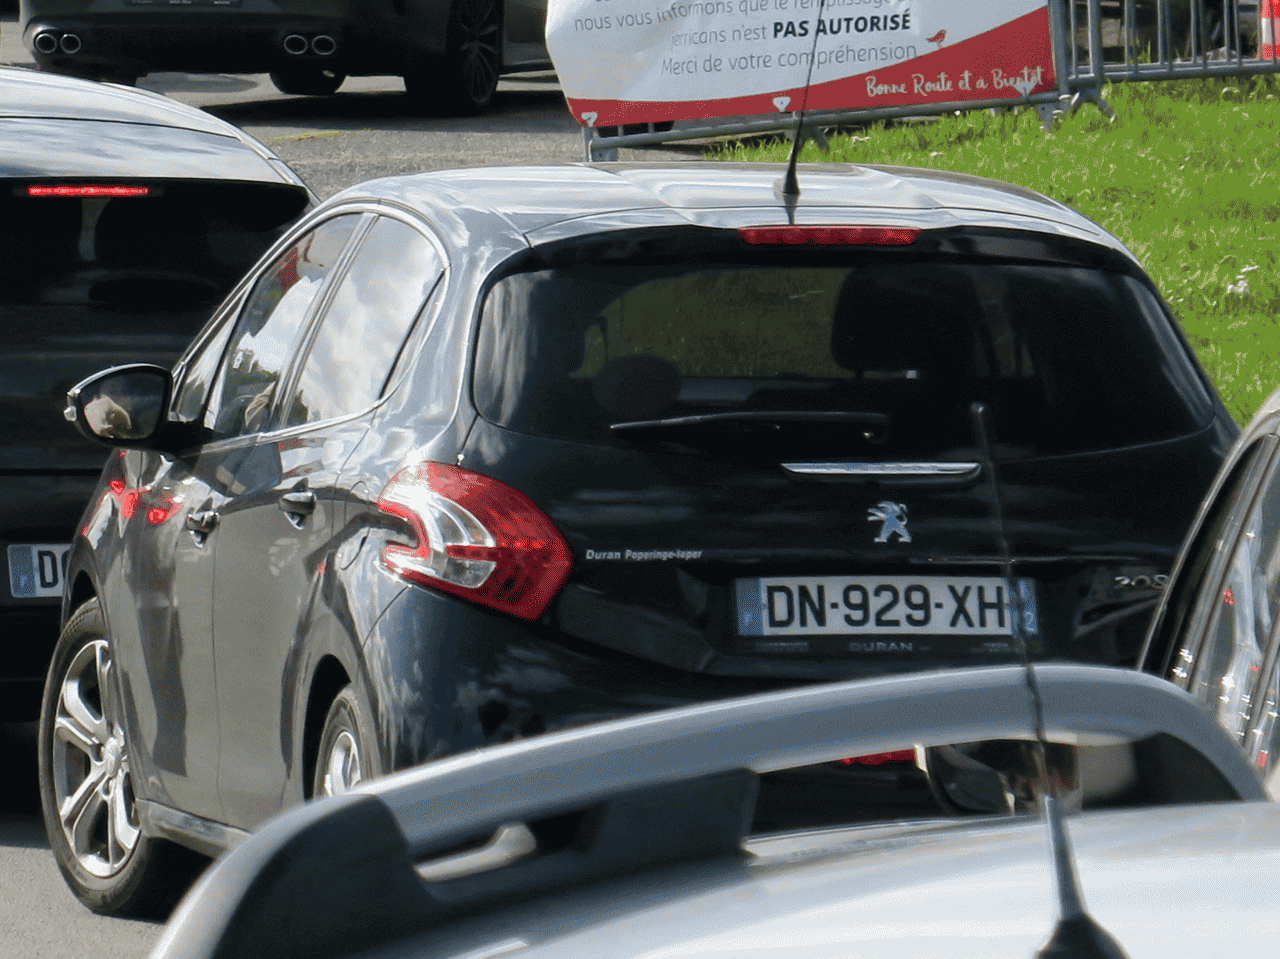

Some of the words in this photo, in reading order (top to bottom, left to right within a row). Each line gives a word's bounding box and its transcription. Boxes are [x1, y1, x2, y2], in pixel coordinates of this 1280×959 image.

[574, 16, 612, 32] nous
[615, 10, 653, 28] vous
[772, 19, 810, 40] PAS
[816, 7, 912, 36] AUTORISÉ
[660, 57, 699, 77] Merci
[702, 53, 724, 73] de
[727, 52, 773, 71] votre
[865, 74, 908, 98] Bonne
[911, 71, 954, 97] Route
[957, 69, 973, 91] et
[976, 76, 988, 90] à
[991, 65, 1045, 91] Bientôt
[585, 548, 621, 560] Duran
[765, 583, 1007, 629] DN-929-XH
[848, 641, 914, 653] DURAN
